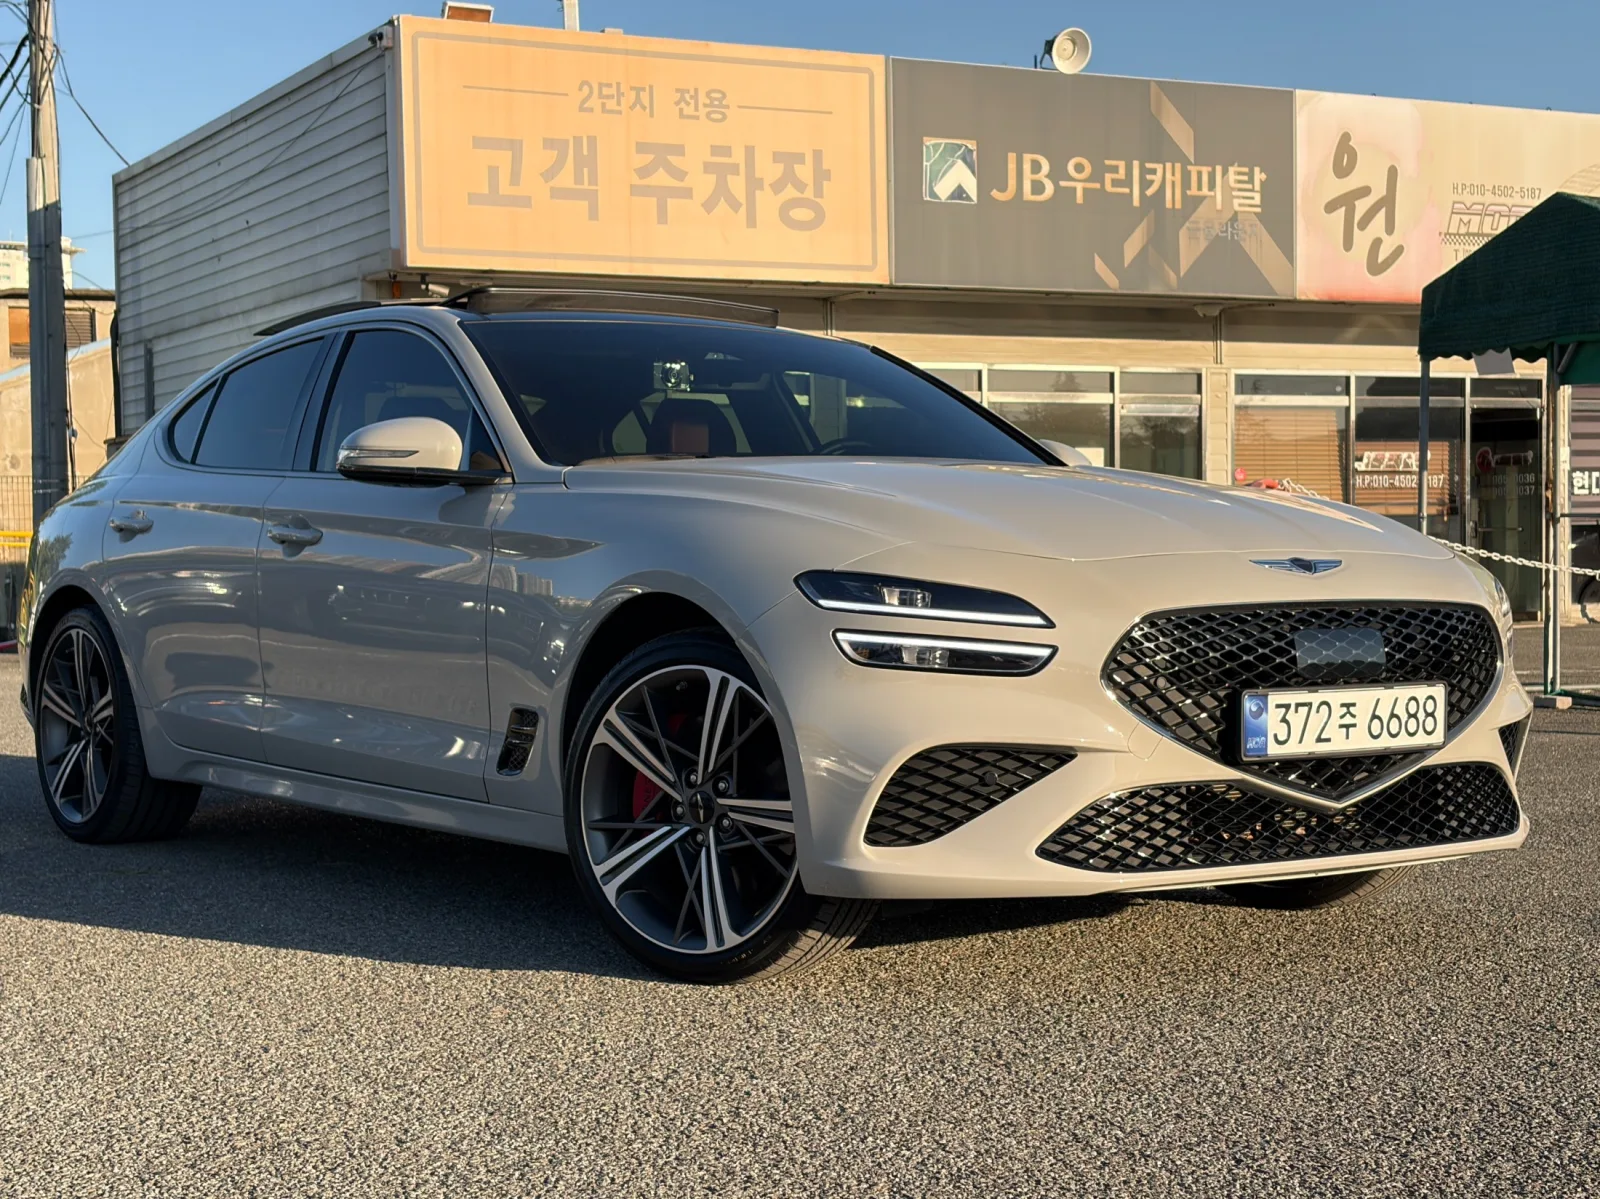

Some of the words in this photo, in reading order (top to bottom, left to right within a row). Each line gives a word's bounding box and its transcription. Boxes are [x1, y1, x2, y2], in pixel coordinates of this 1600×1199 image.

[577, 80, 655, 118] 2단지
[673, 87, 730, 123] 전용
[467, 135, 600, 221] 고객
[629, 141, 831, 232] 주차장
[990, 151, 1267, 213] JB우리캐피탈
[1323, 131, 1404, 276] 원
[1273, 700, 1357, 746] 372주
[1367, 694, 1438, 740] 6688
